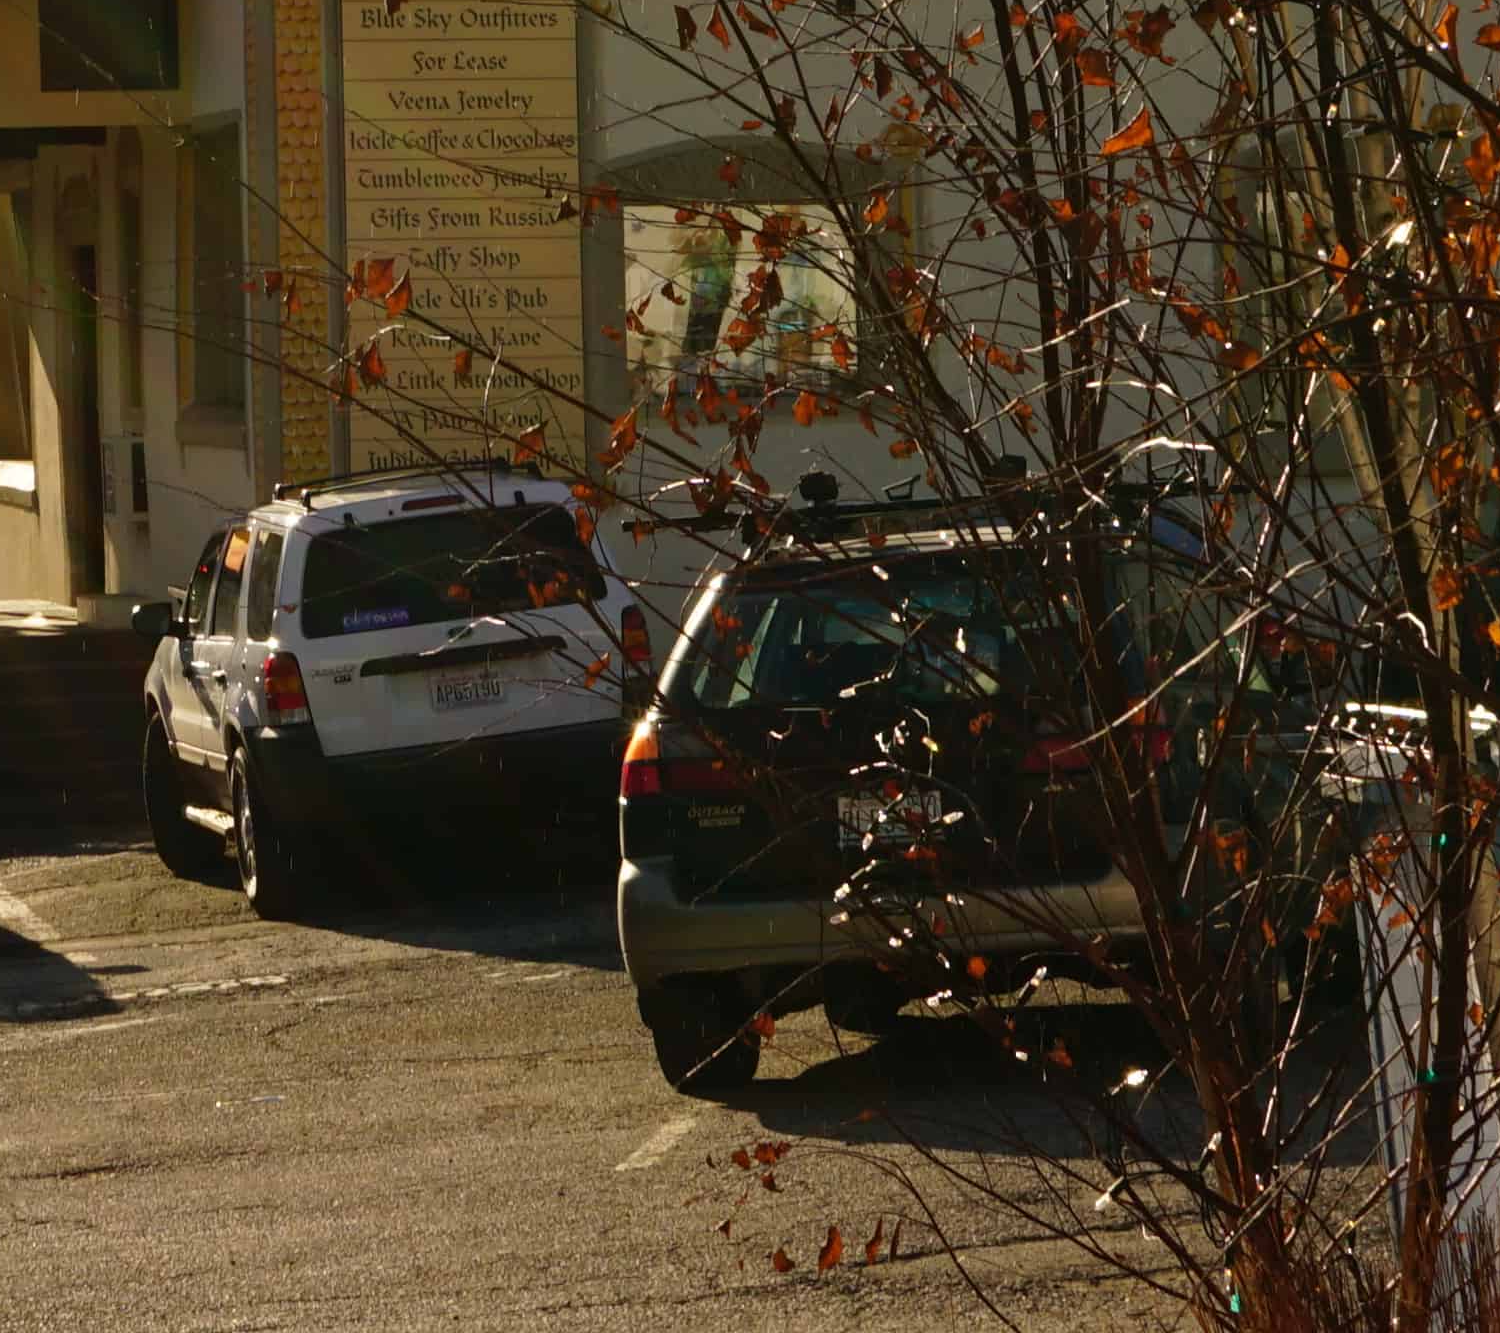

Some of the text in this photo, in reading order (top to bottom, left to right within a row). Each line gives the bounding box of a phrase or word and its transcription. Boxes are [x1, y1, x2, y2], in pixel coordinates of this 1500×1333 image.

[360, 7, 559, 33] Blue Sky Outfitters
[412, 50, 508, 74] For Lease
[388, 89, 534, 115] Veena Jewelry
[350, 128, 577, 154] Icicle Coffee & Chocolates
[357, 165, 569, 192] Tumbleweed Jewelry
[370, 206, 422, 232] Gifts
[427, 206, 481, 231] From
[408, 245, 521, 272] Taffy Shop
[504, 286, 549, 313] Pub
[396, 368, 447, 390] Little
